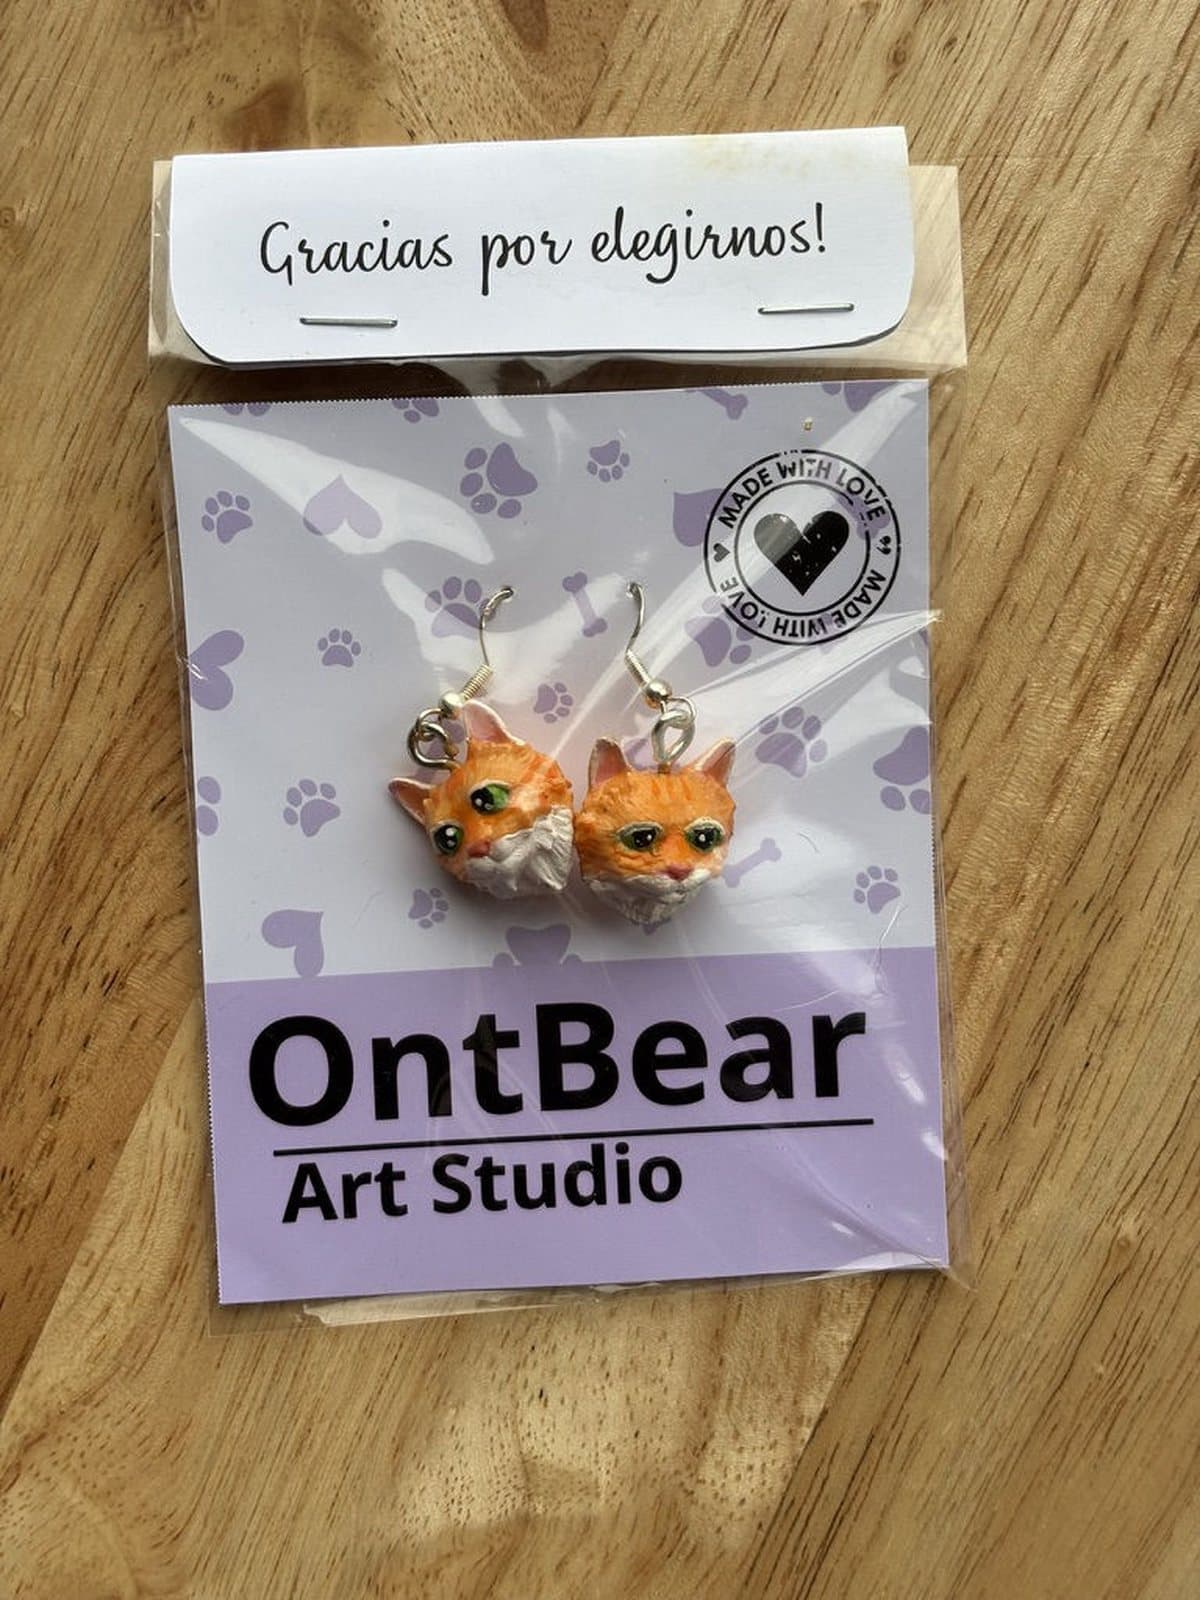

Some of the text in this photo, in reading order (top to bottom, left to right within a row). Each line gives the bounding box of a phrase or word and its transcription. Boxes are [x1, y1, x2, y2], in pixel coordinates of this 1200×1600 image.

[260, 202, 827, 296] Gracias por elegirnos!
[718, 458, 886, 528] MADE WITH LOVE
[773, 617, 827, 638] WITH
[831, 569, 886, 628] MADE
[248, 1002, 867, 1127] OntBear
[281, 1142, 683, 1224] Art Studio
